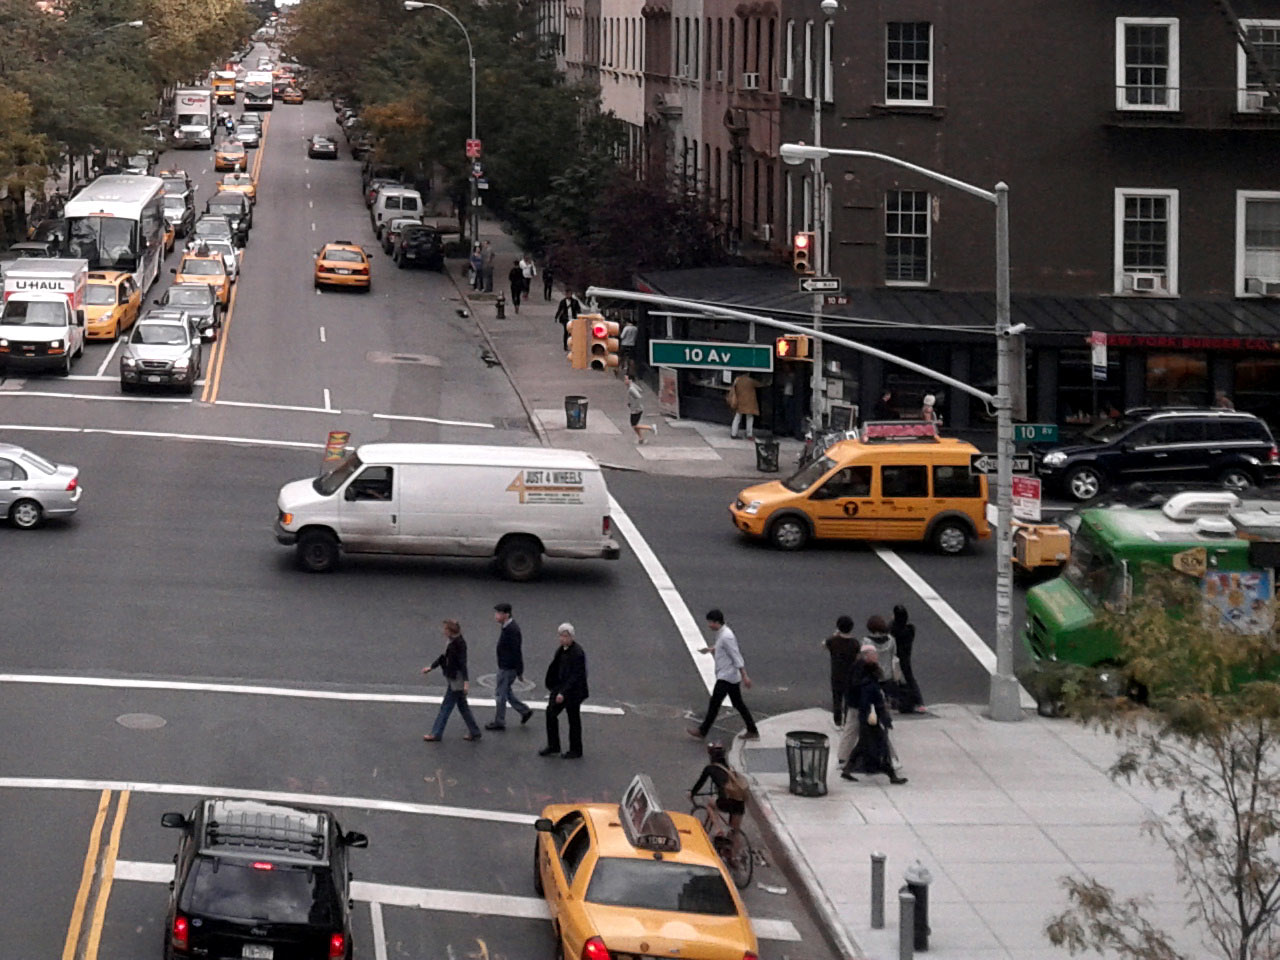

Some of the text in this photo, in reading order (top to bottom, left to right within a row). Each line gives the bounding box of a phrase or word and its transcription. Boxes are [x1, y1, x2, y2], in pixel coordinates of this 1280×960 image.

[684, 347, 731, 363] 10 Av
[1020, 426, 1036, 439] 10
[980, 460, 997, 469] ONE
[526, 471, 544, 484] JUST
[553, 471, 583, 485] WHEELS
